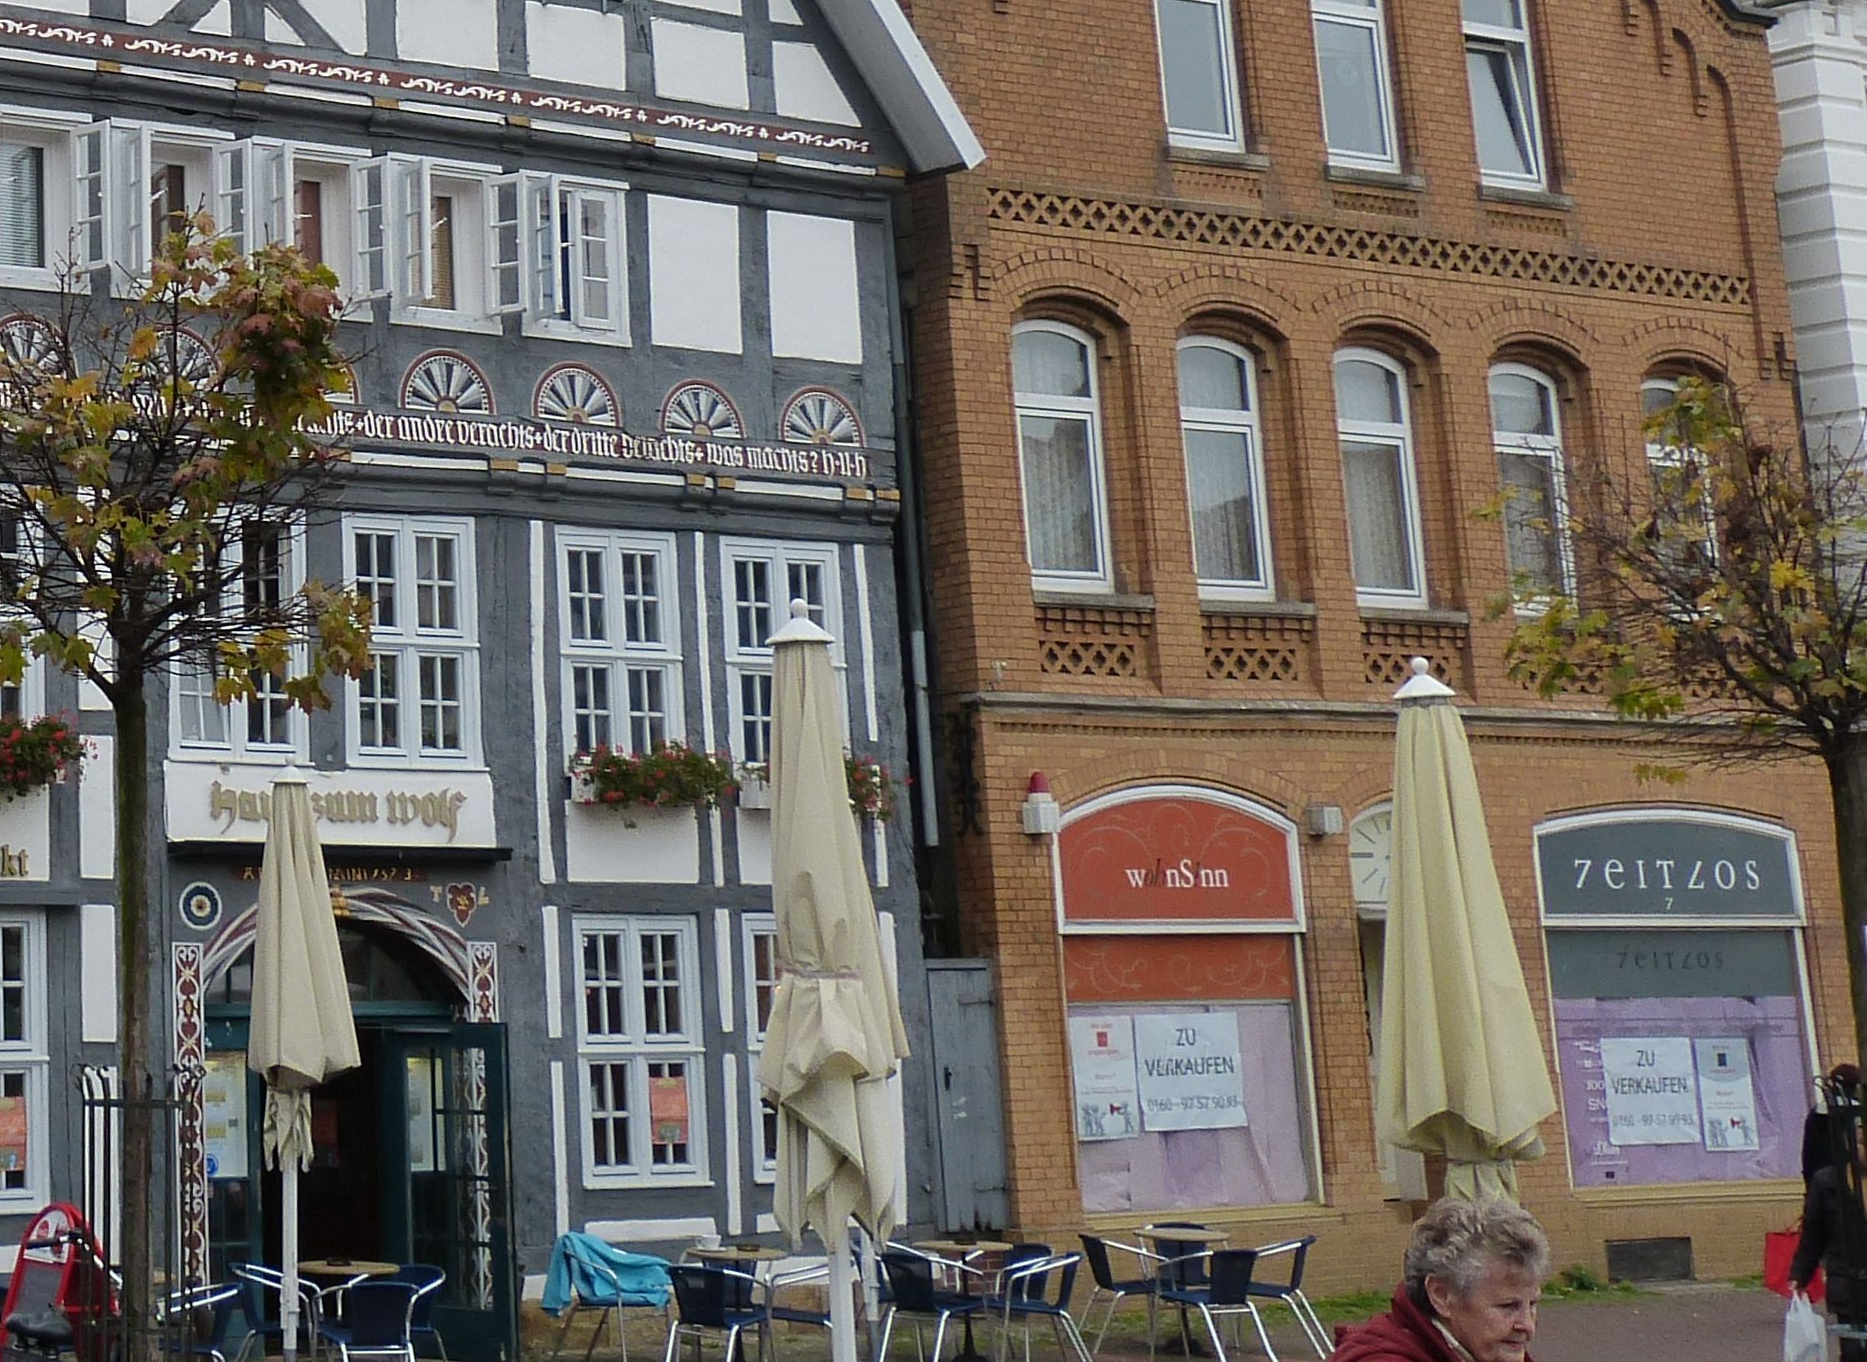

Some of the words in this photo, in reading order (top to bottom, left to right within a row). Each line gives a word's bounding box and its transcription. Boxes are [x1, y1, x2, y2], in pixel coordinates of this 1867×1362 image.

[706, 442, 744, 467] was
[310, 790, 379, 824] zum
[1175, 1028, 1197, 1046] ZU
[1144, 1056, 1235, 1077] VERKAUFEN
[1636, 1049, 1656, 1067] ZU
[1611, 1076, 1689, 1095] VERKAUFEN
